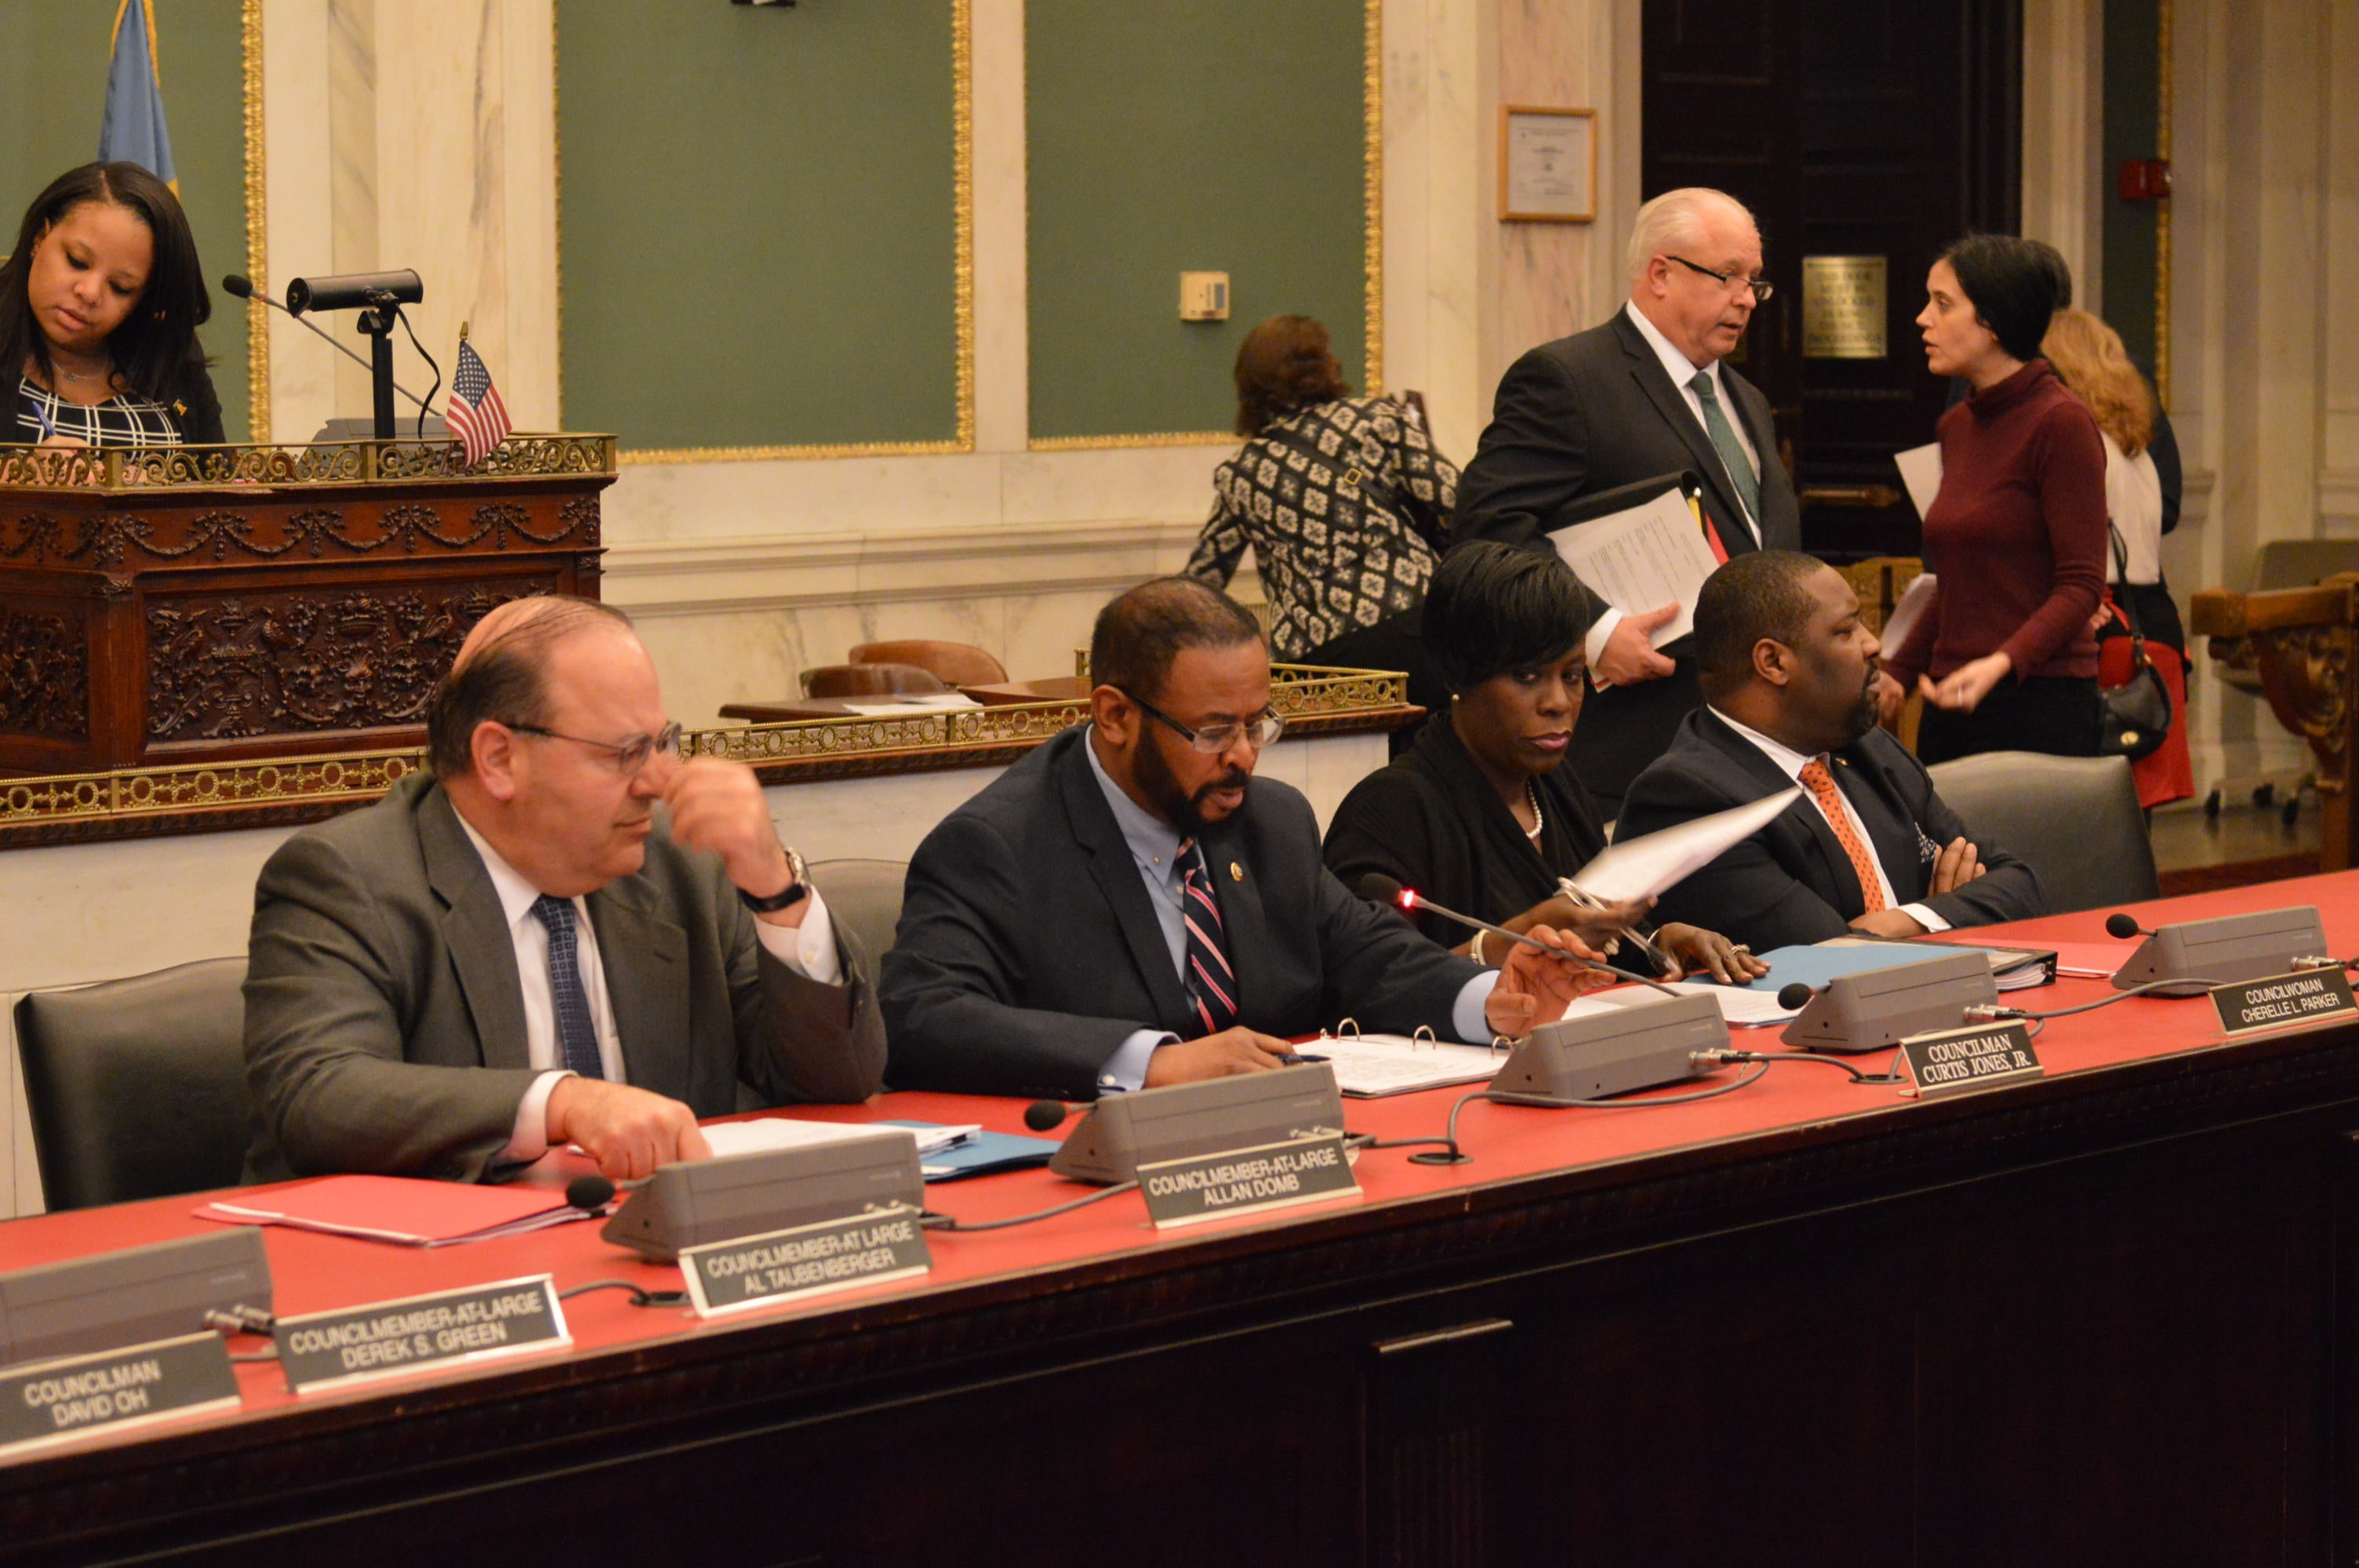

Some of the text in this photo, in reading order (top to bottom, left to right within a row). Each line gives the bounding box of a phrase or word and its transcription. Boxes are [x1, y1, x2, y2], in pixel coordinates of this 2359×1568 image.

[2241, 1001, 2292, 1022] CHERELLE
[2300, 993, 2340, 1011] PARKER
[2246, 978, 2324, 1004] COUNCILWOMAN
[1923, 1051, 2031, 1083] CURTIS JONES, JR.
[1928, 1034, 2012, 1063] COUNCILMAN
[1148, 1148, 1339, 1196] COUNCILMEMBER-AT-LARGE
[1204, 1175, 1300, 1207] ALLAN DOMB
[745, 1247, 896, 1294] AL TAUBENBERGER
[289, 1290, 544, 1355] COUNCILMEMBER-AT-LARGE
[341, 1322, 508, 1369] DEREK S. GREEN
[24, 1359, 162, 1407] COUNCILMAN
[51, 1387, 150, 1428] DAVID OH
